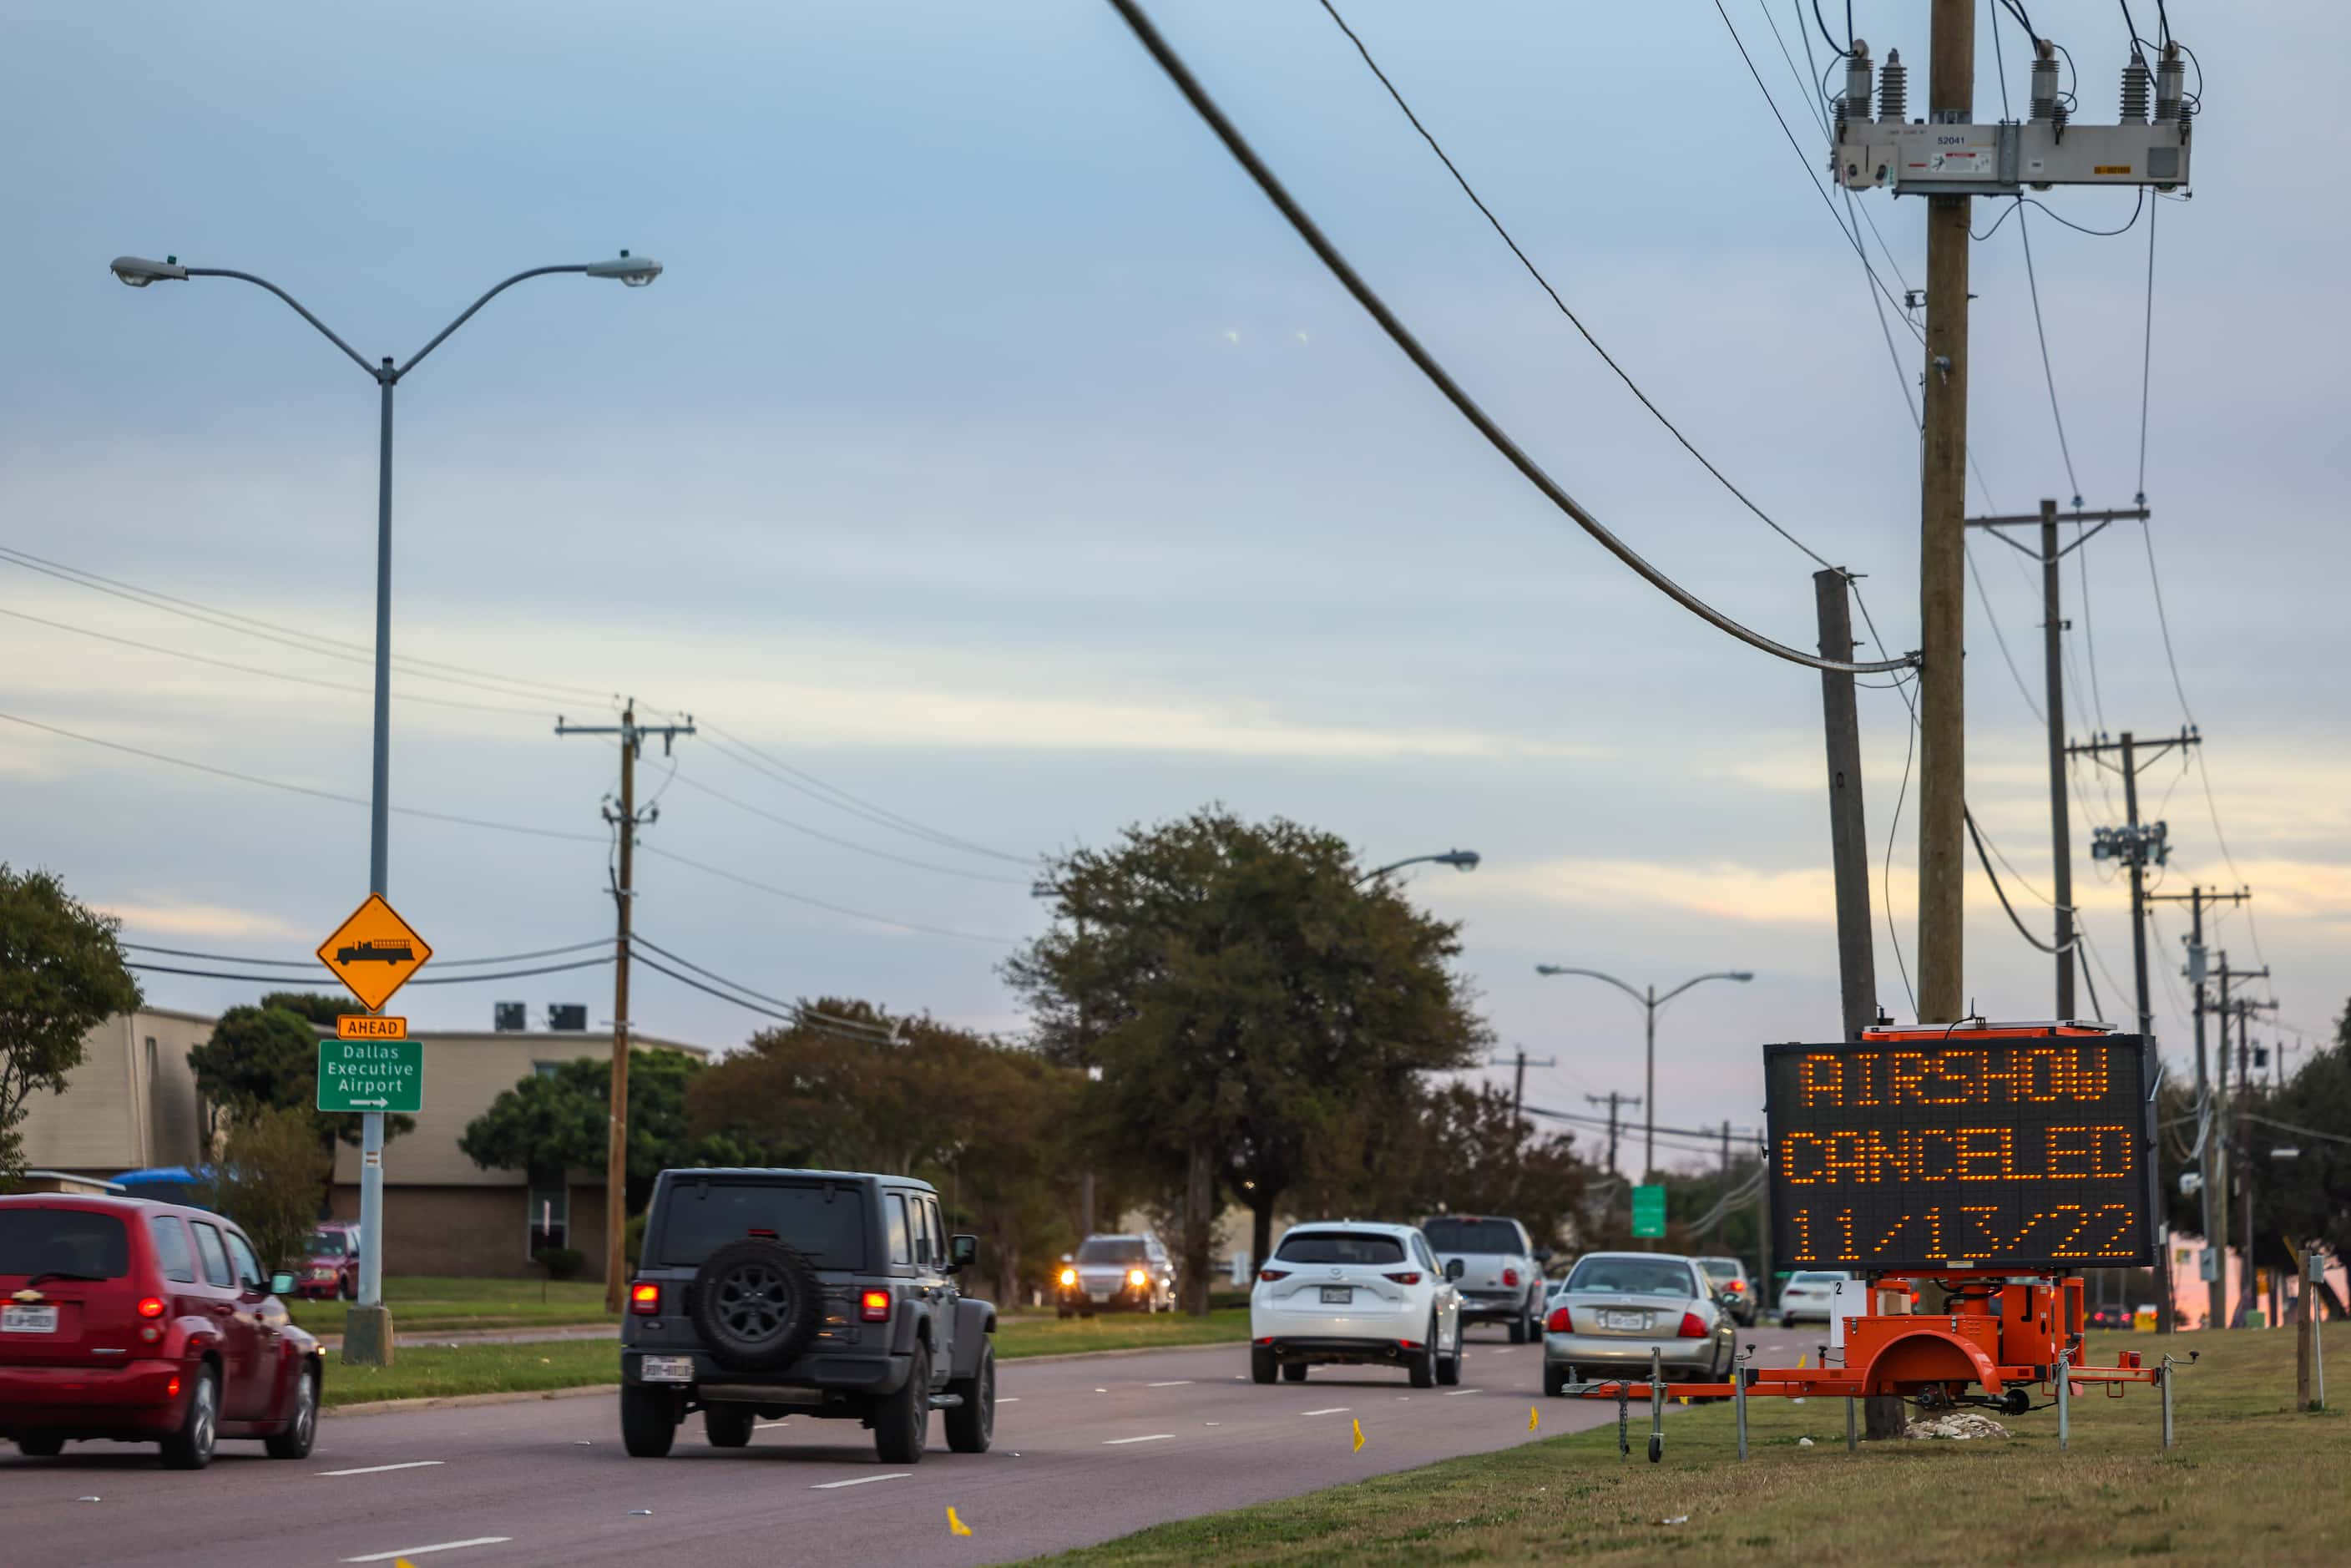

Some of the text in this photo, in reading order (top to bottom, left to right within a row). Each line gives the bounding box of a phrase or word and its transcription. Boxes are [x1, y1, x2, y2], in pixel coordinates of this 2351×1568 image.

[1938, 136, 1965, 145] 52041
[348, 1021, 397, 1034] AHEAD
[344, 1045, 398, 1059] Dallas
[328, 1063, 413, 1075] Executive
[1799, 1048, 2108, 1106] AIRSHOW
[339, 1078, 402, 1094] Airport
[1782, 1125, 2132, 1183] CANCELED
[1792, 1203, 2135, 1262] 11/13/22
[1836, 1282, 1842, 1295] 2
